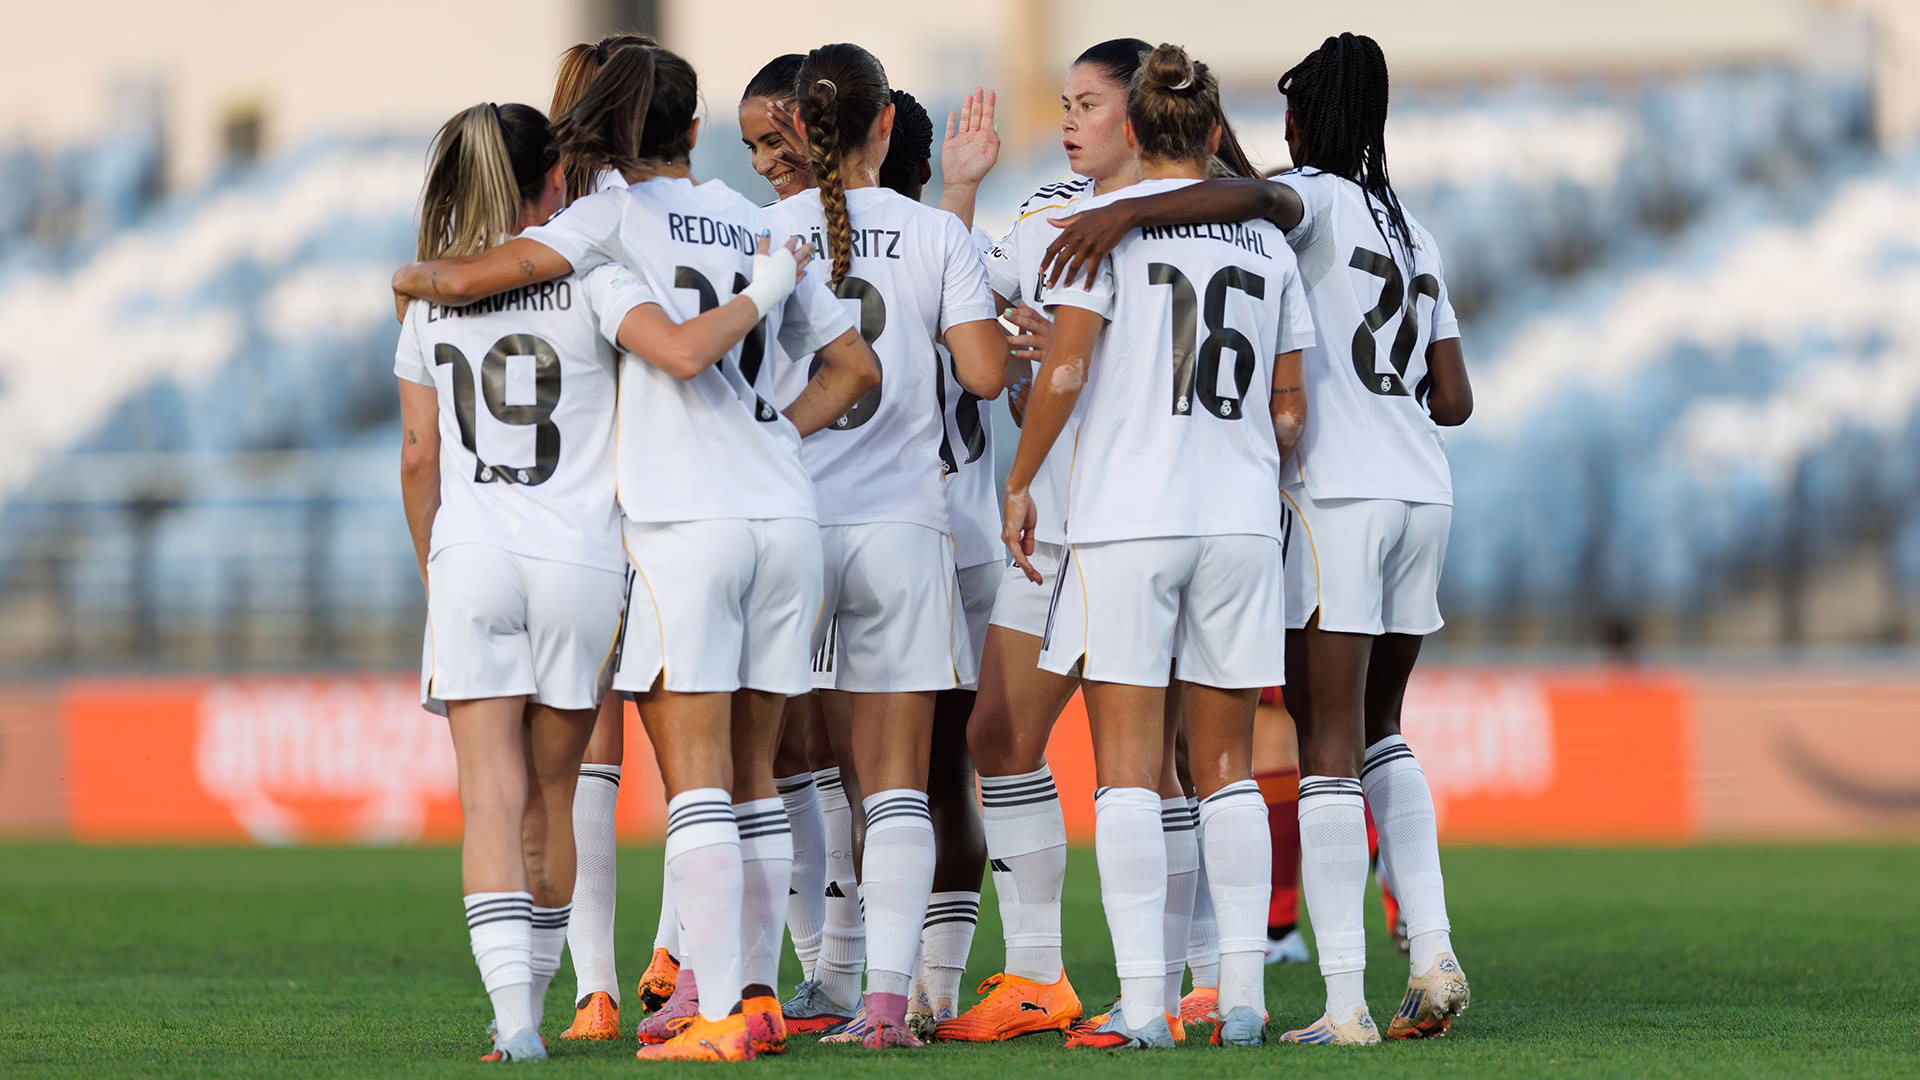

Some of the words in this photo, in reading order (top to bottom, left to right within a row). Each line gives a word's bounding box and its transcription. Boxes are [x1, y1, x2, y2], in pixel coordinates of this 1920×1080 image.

[790, 226, 901, 260] DÄRITZ
[1141, 222, 1273, 260] ANGELDAHL
[1147, 262, 1266, 420] 16
[434, 333, 562, 487] 19
